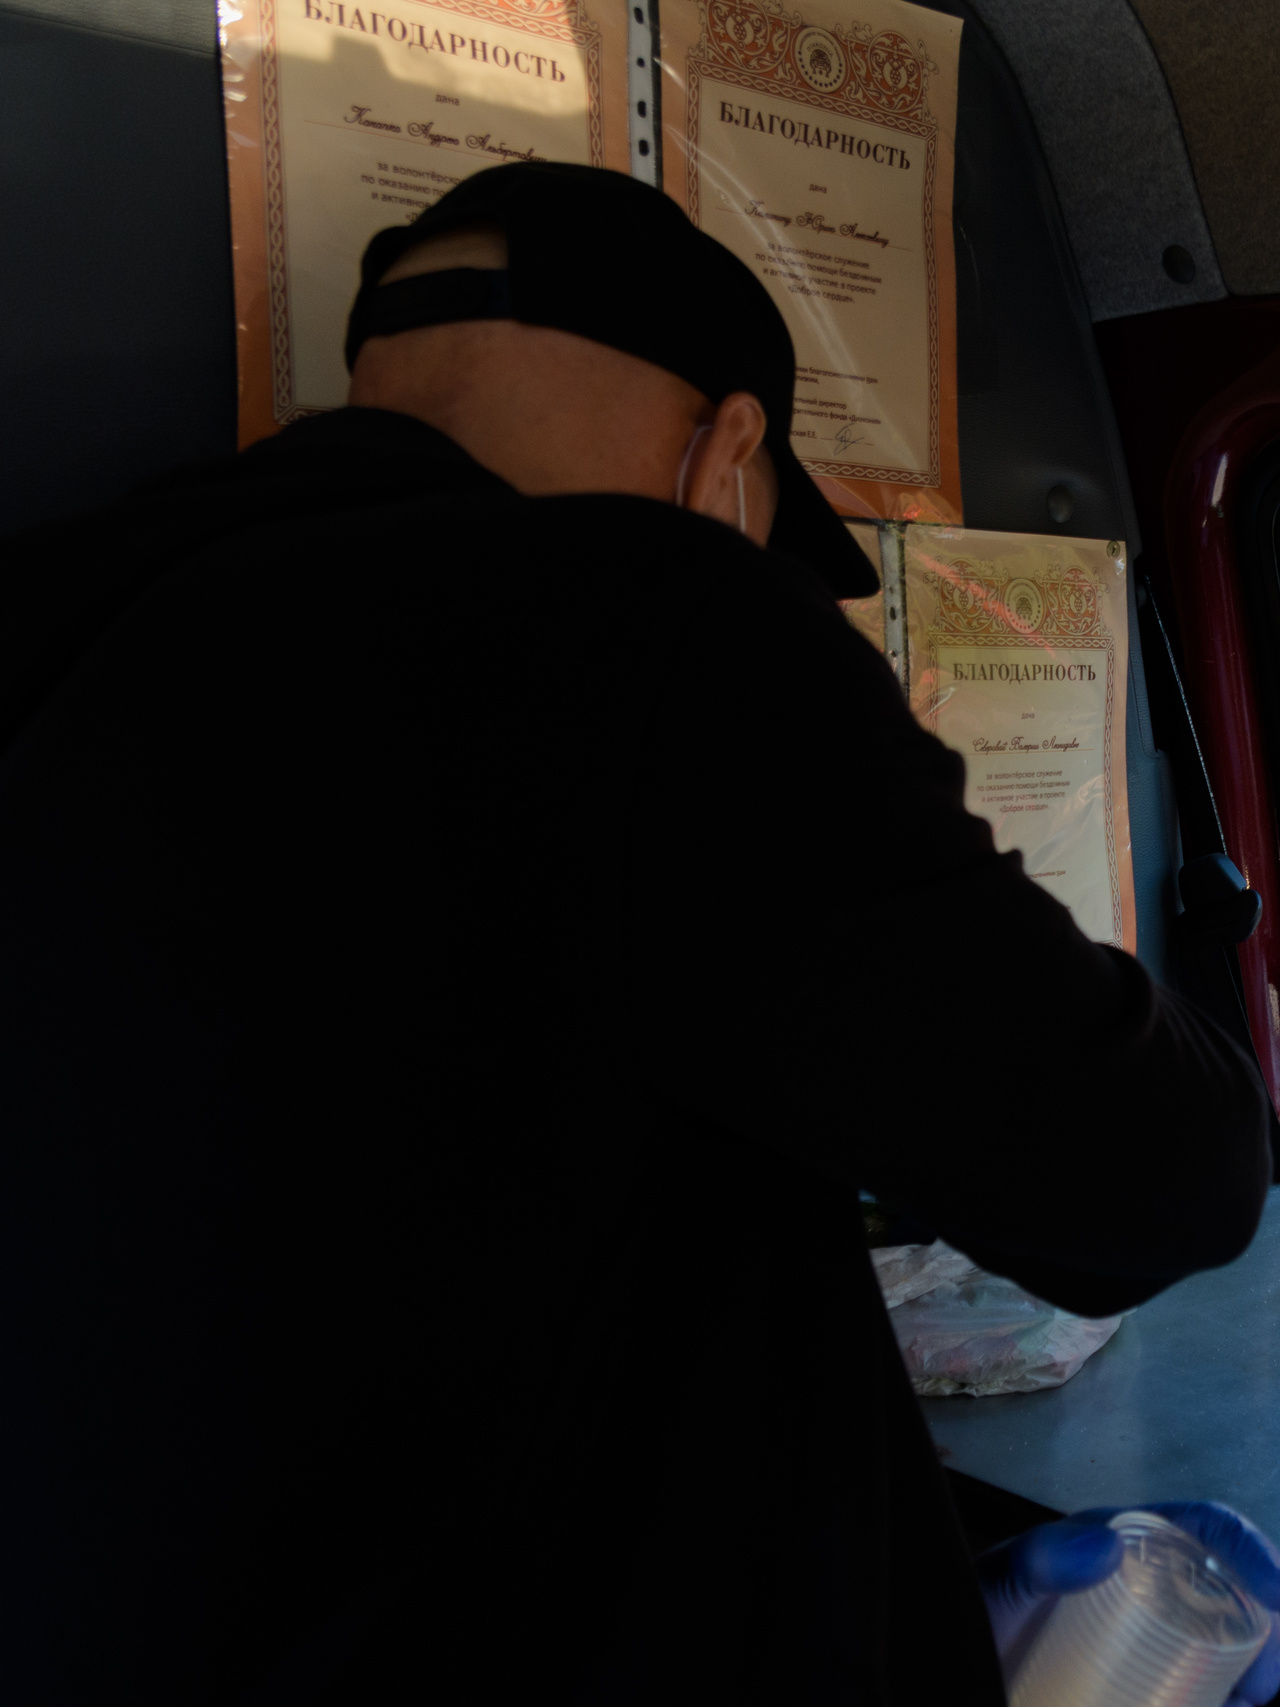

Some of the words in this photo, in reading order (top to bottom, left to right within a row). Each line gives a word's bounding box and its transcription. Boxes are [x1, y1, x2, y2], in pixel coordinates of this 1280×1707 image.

[304, 0, 566, 83] БЛАГОДАРНОСТЬ
[436, 95, 460, 106] дана
[719, 101, 911, 170] БЛАГОДАРНОСТЬ
[377, 162, 389, 172] за
[393, 166, 462, 185] волонтёрско
[361, 175, 375, 184] по
[379, 178, 431, 195] оказанию
[809, 183, 828, 194] дана
[755, 252, 766, 262] по
[807, 263, 839, 277] помощи
[839, 268, 882, 284] бездомным
[834, 255, 870, 270] служение
[847, 284, 877, 296] проекте
[953, 663, 1097, 684] БЛАГОДАРНОСТЬ
[1021, 712, 1035, 720] дана
[995, 770, 1035, 781] волонтёрское
[1036, 769, 1063, 779] служение
